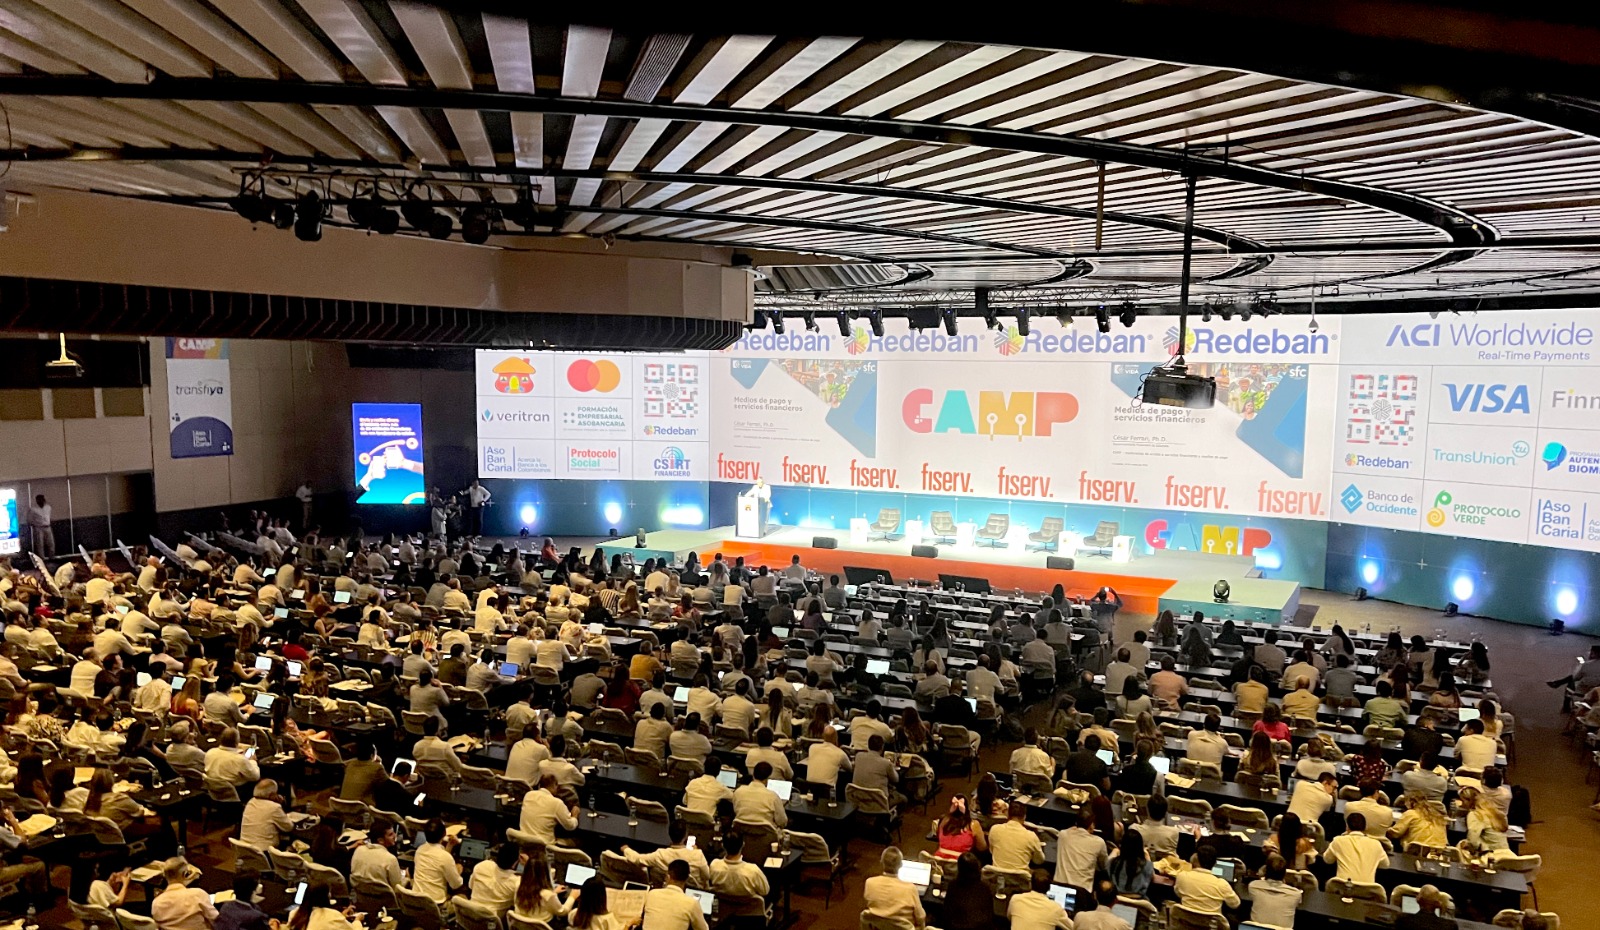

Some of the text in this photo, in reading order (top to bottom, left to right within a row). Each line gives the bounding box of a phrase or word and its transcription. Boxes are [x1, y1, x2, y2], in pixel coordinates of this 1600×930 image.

[736, 330, 830, 351] Redeban
[1022, 329, 1145, 353] Redeban
[1192, 328, 1328, 354] Redeban
[1386, 322, 1593, 346] ACI Worldwide
[867, 330, 979, 353] Redeban
[1478, 351, 1590, 362] Real-Time Payments
[1289, 365, 1307, 377] sfc
[1441, 383, 1531, 414] VISA
[497, 410, 550, 422] veritran
[902, 388, 1079, 441] CAMP
[1114, 406, 1145, 414] Medios
[1161, 408, 1184, 417] pago
[1114, 414, 1206, 424] servicios financieros
[654, 426, 697, 435] Redeban
[487, 446, 505, 454] Aso
[571, 448, 617, 458] Protocolo
[1433, 448, 1516, 466] TransUnion
[487, 455, 505, 463] Ban
[571, 458, 600, 467] Social
[1357, 455, 1409, 469] Redeban
[487, 464, 512, 472] Caria
[717, 452, 760, 481] fiserv
[782, 456, 830, 485] fiserv.
[1569, 464, 1600, 474] BIOM
[850, 459, 899, 489] fiserv.
[921, 463, 973, 493] fiserv.
[998, 466, 1054, 498] fiserv.
[1079, 470, 1138, 504] fiserv.
[1165, 475, 1229, 510] fiserv.
[1257, 480, 1325, 516] fiserv.
[1367, 490, 1414, 504] Banco de
[1366, 502, 1418, 516] Occidente
[1453, 504, 1521, 518] PROTOCOLO
[1542, 499, 1571, 512] Aso
[1453, 513, 1486, 525] VERDE
[1542, 512, 1570, 525] Ban
[1144, 519, 1273, 557] CAMP
[1541, 524, 1579, 539] Caria
